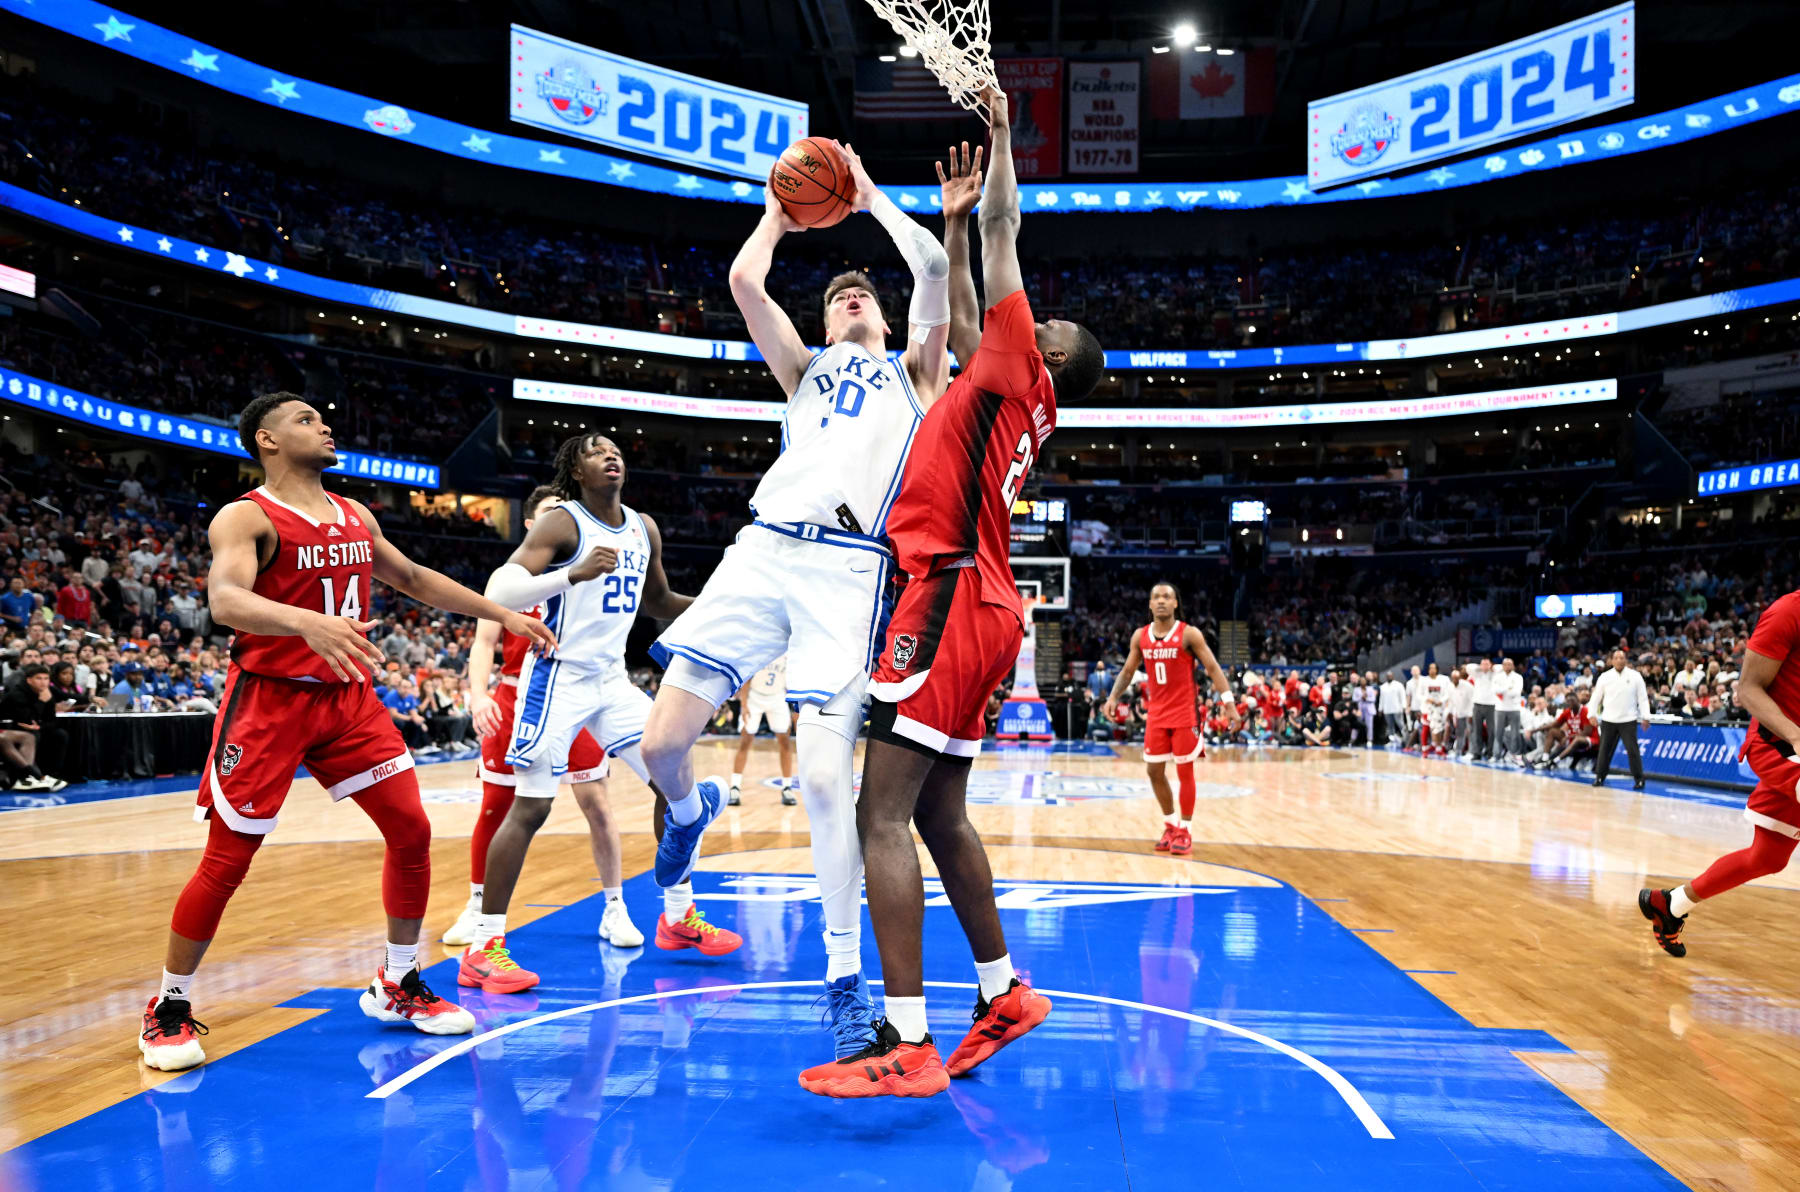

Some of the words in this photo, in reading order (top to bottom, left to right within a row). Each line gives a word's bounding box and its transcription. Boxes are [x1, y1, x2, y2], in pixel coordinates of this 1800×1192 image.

[1410, 28, 1615, 152] 2024
[1092, 99, 1116, 112] NBA
[618, 74, 790, 165] 2024
[1084, 114, 1125, 126] WORLD
[1071, 128, 1137, 142] CHAMPIONS
[1015, 158, 1039, 174] 018
[1075, 149, 1132, 165] 1977-78
[1130, 352, 1187, 367] WOLFPACK
[821, 379, 867, 428] 0
[1488, 391, 1553, 406] TOURNAMENT
[358, 457, 436, 484] ACCOMPL
[1000, 430, 1034, 520] 2
[1697, 470, 1740, 493] LISH
[1750, 463, 1799, 486] GREA
[297, 544, 325, 570] NC
[328, 540, 373, 567] STATE
[616, 549, 648, 574] KE
[319, 573, 362, 621] 14
[602, 575, 639, 613] 25
[1152, 647, 1178, 660] STATE
[765, 672, 776, 686] 3
[1154, 661, 1167, 685] 0
[1652, 739, 1738, 765] ACCOMPLISH
[371, 760, 399, 781] PACK
[572, 771, 591, 781] PACK
